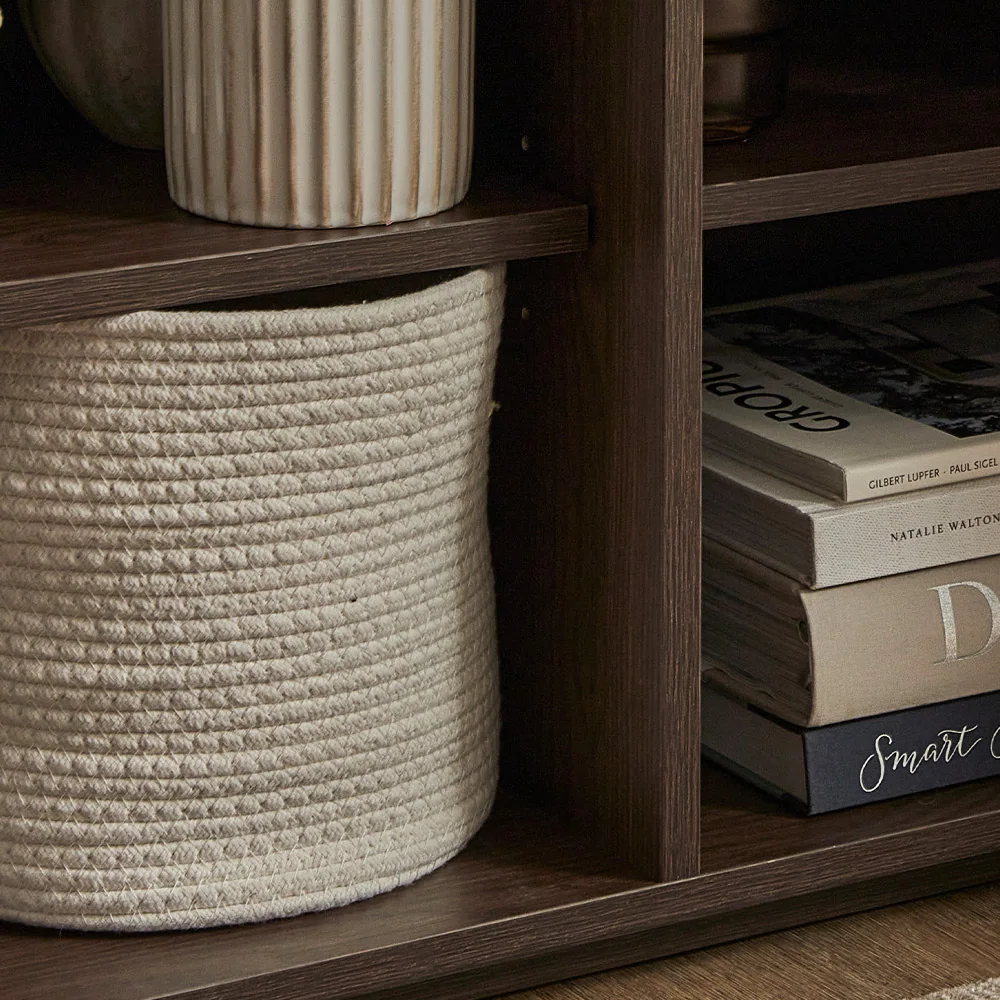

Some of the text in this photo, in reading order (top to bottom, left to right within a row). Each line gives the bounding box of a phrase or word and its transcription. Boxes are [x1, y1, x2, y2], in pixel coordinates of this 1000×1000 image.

[868, 457, 999, 490] GILBERT LUPFER PAUL SIGEL
[890, 522, 944, 543] NATALIE
[859, 725, 982, 793] Smart
